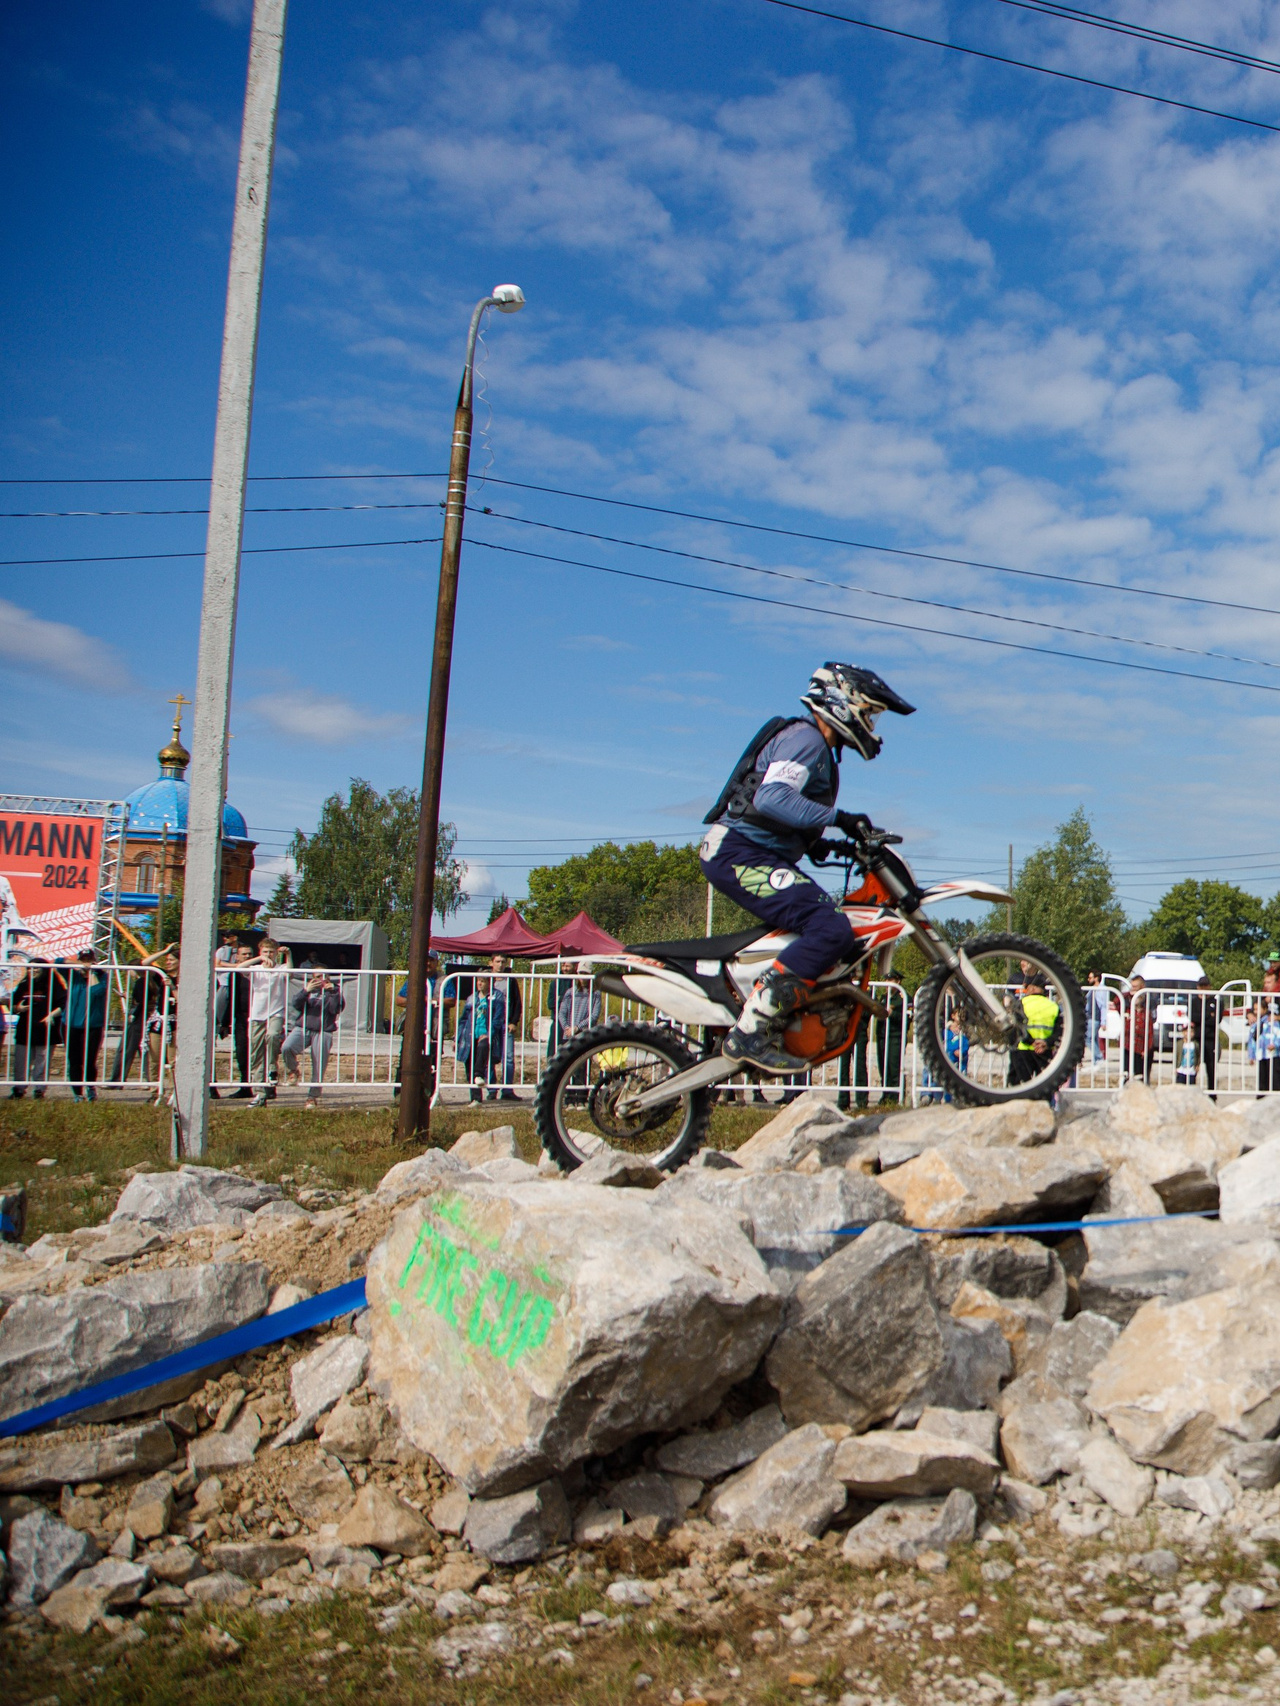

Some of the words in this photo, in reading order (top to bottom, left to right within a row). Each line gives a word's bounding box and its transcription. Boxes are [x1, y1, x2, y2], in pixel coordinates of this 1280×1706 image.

[0, 820, 96, 859] MANN
[43, 864, 89, 889] 2024
[468, 1269, 555, 1369] CUP
